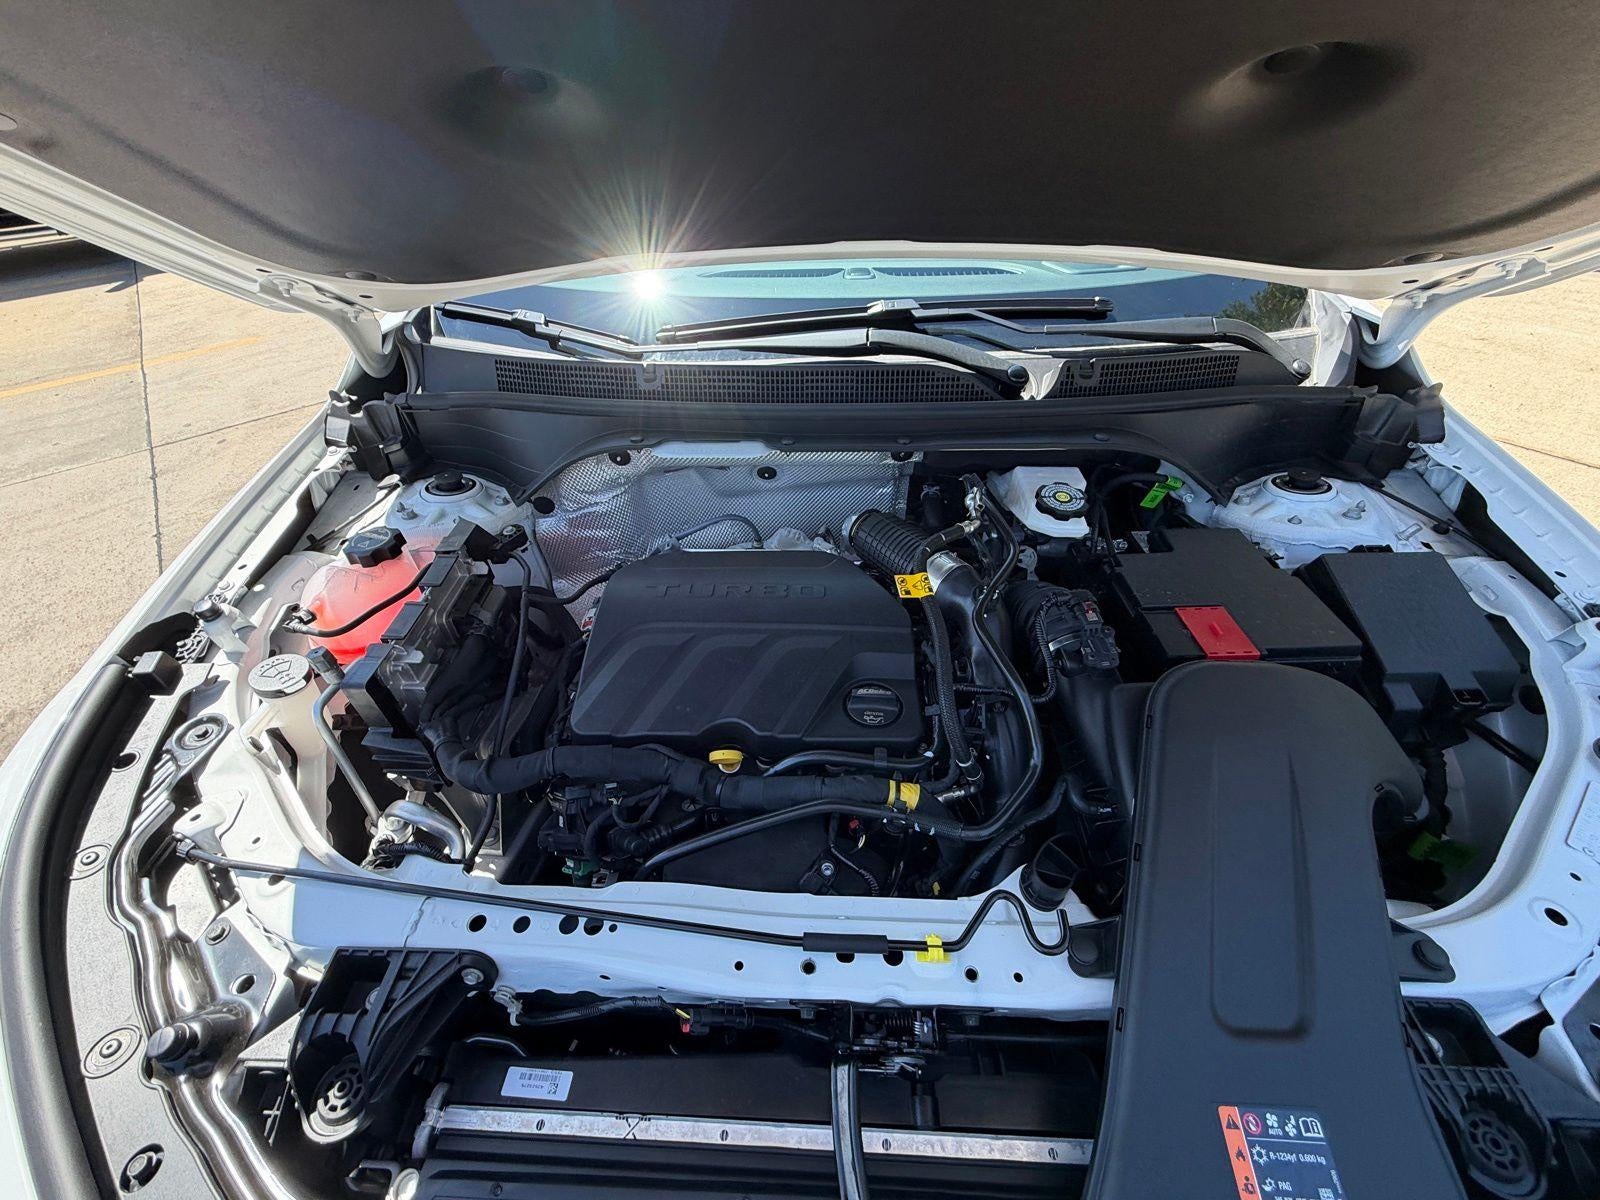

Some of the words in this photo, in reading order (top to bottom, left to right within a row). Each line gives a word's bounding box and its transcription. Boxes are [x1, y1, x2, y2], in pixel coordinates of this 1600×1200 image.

[646, 583, 827, 598] TURBO
[1268, 1128, 1283, 1136] AUTO
[1269, 1151, 1297, 1163] R-1234yf
[1317, 1154, 1326, 1165] kg
[1278, 1181, 1292, 1191] PAG
